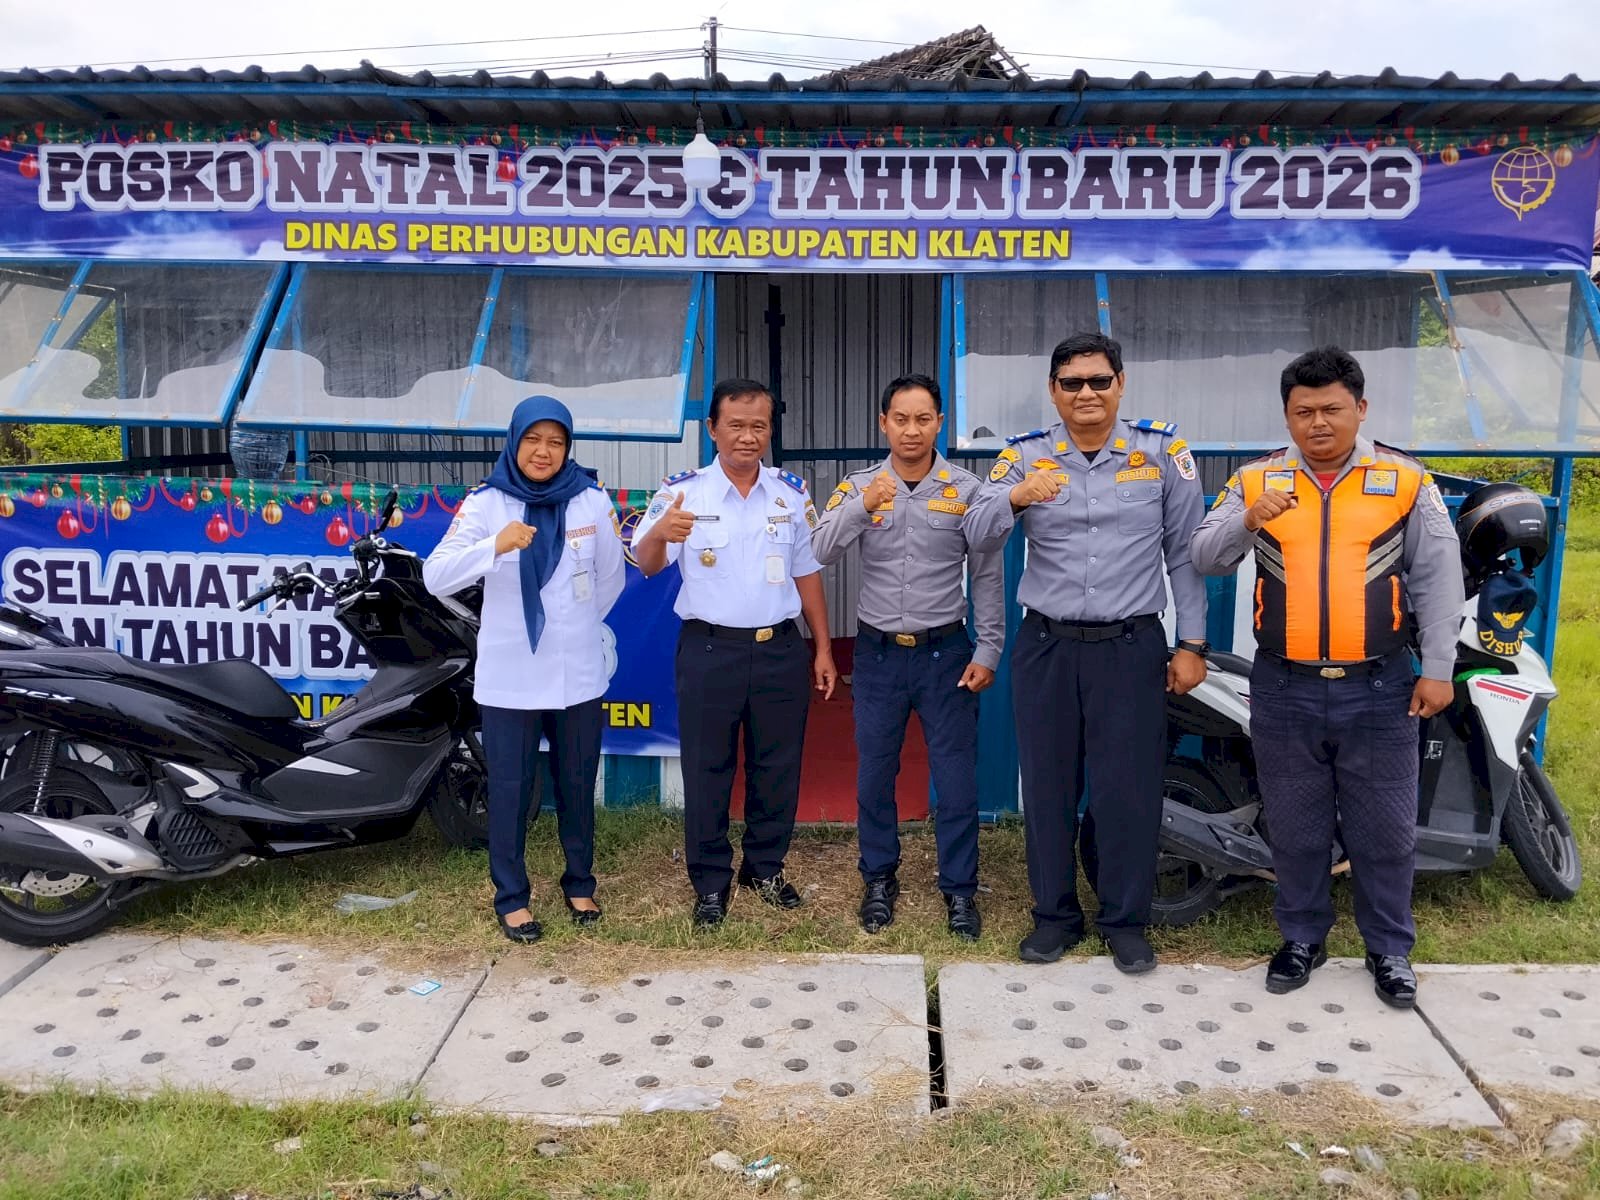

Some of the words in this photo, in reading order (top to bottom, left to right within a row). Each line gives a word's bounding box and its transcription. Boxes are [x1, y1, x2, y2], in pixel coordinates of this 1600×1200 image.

[44, 149, 256, 206] POSKO
[271, 150, 509, 207] NATAL
[523, 154, 690, 209] 2025
[764, 154, 1009, 211] TAHUN
[1025, 154, 1225, 211] BARU
[1238, 154, 1416, 211] 2026
[285, 221, 398, 252] DINAS
[407, 223, 686, 257] PERHUBUNGAN
[697, 227, 917, 258] KABUPATEN
[928, 229, 1070, 259] KLATEN
[12, 558, 260, 610] SELAMAT
[120, 618, 292, 668] TAHUN
[307, 623, 378, 670] BA
[1489, 692, 1520, 705] HONDA
